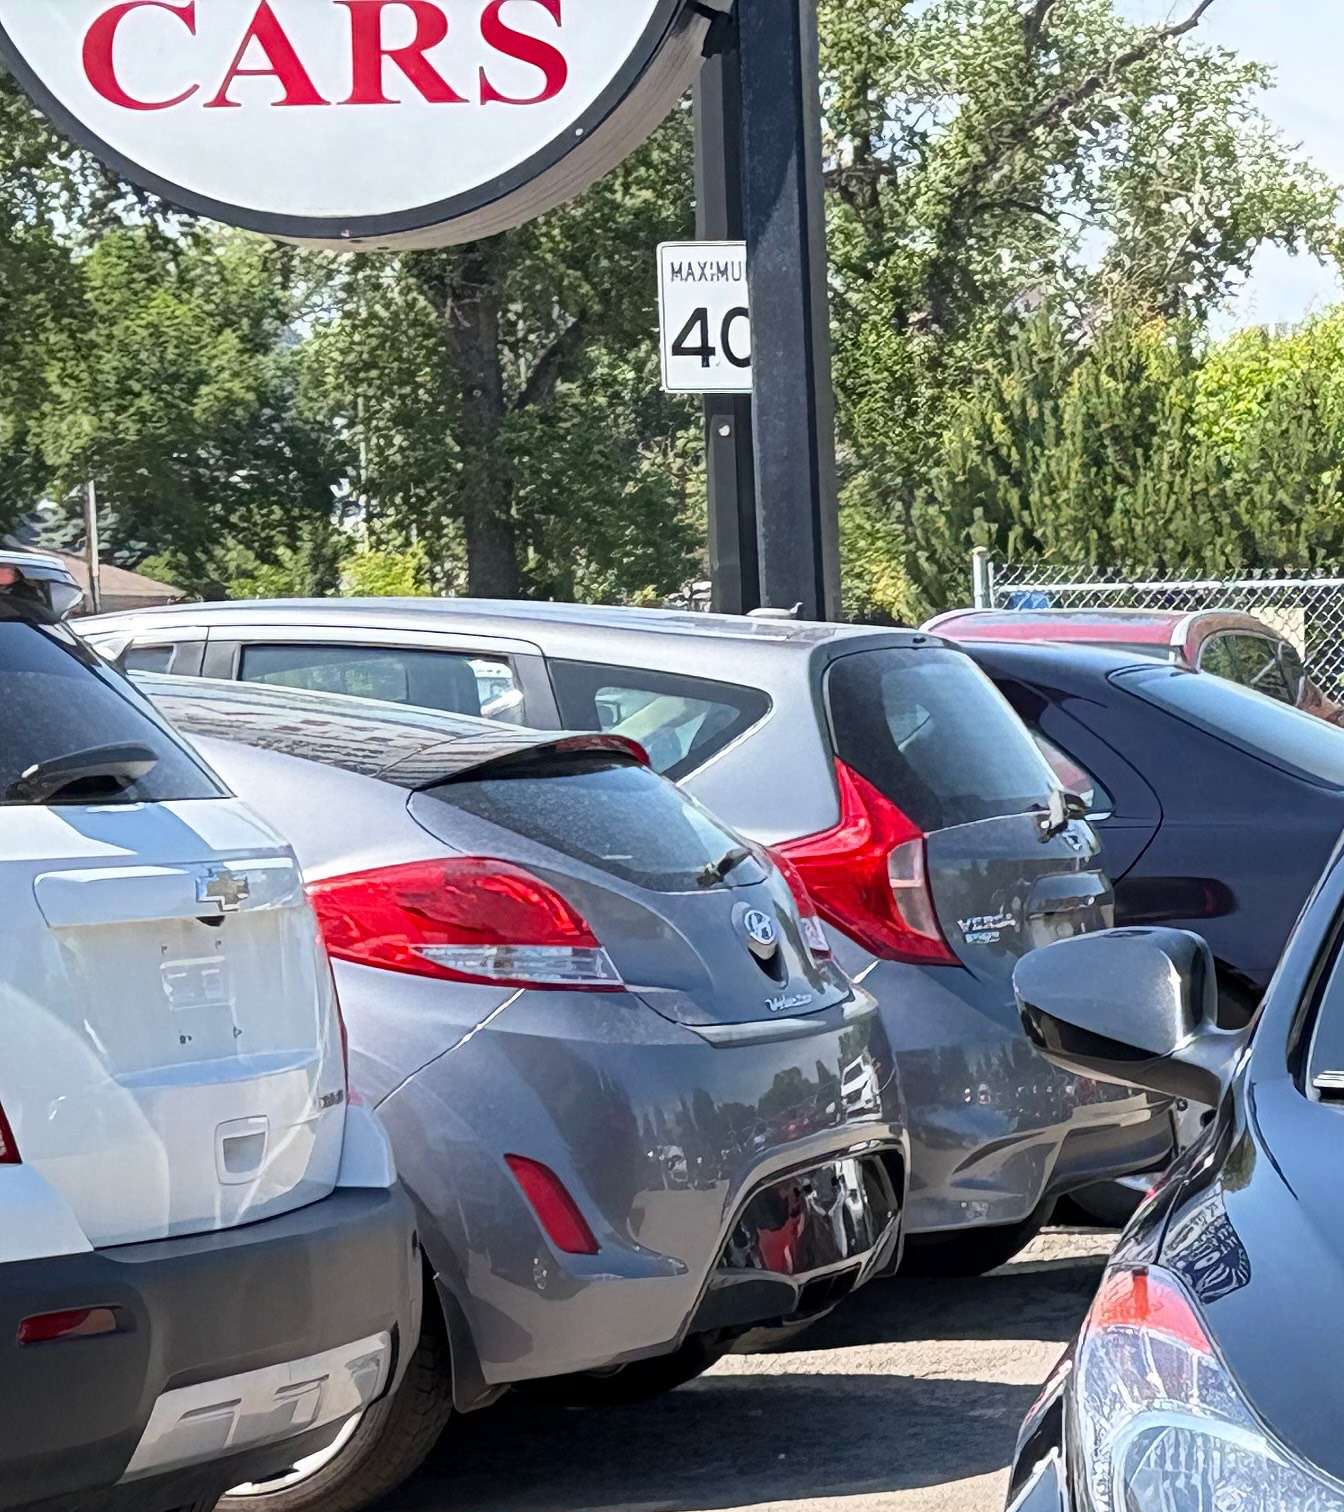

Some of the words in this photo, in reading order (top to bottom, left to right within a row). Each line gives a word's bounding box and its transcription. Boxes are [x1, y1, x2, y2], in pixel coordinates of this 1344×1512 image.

[82, 0, 568, 111] CARS
[670, 260, 742, 282] MAXIMU
[671, 306, 752, 368] 40
